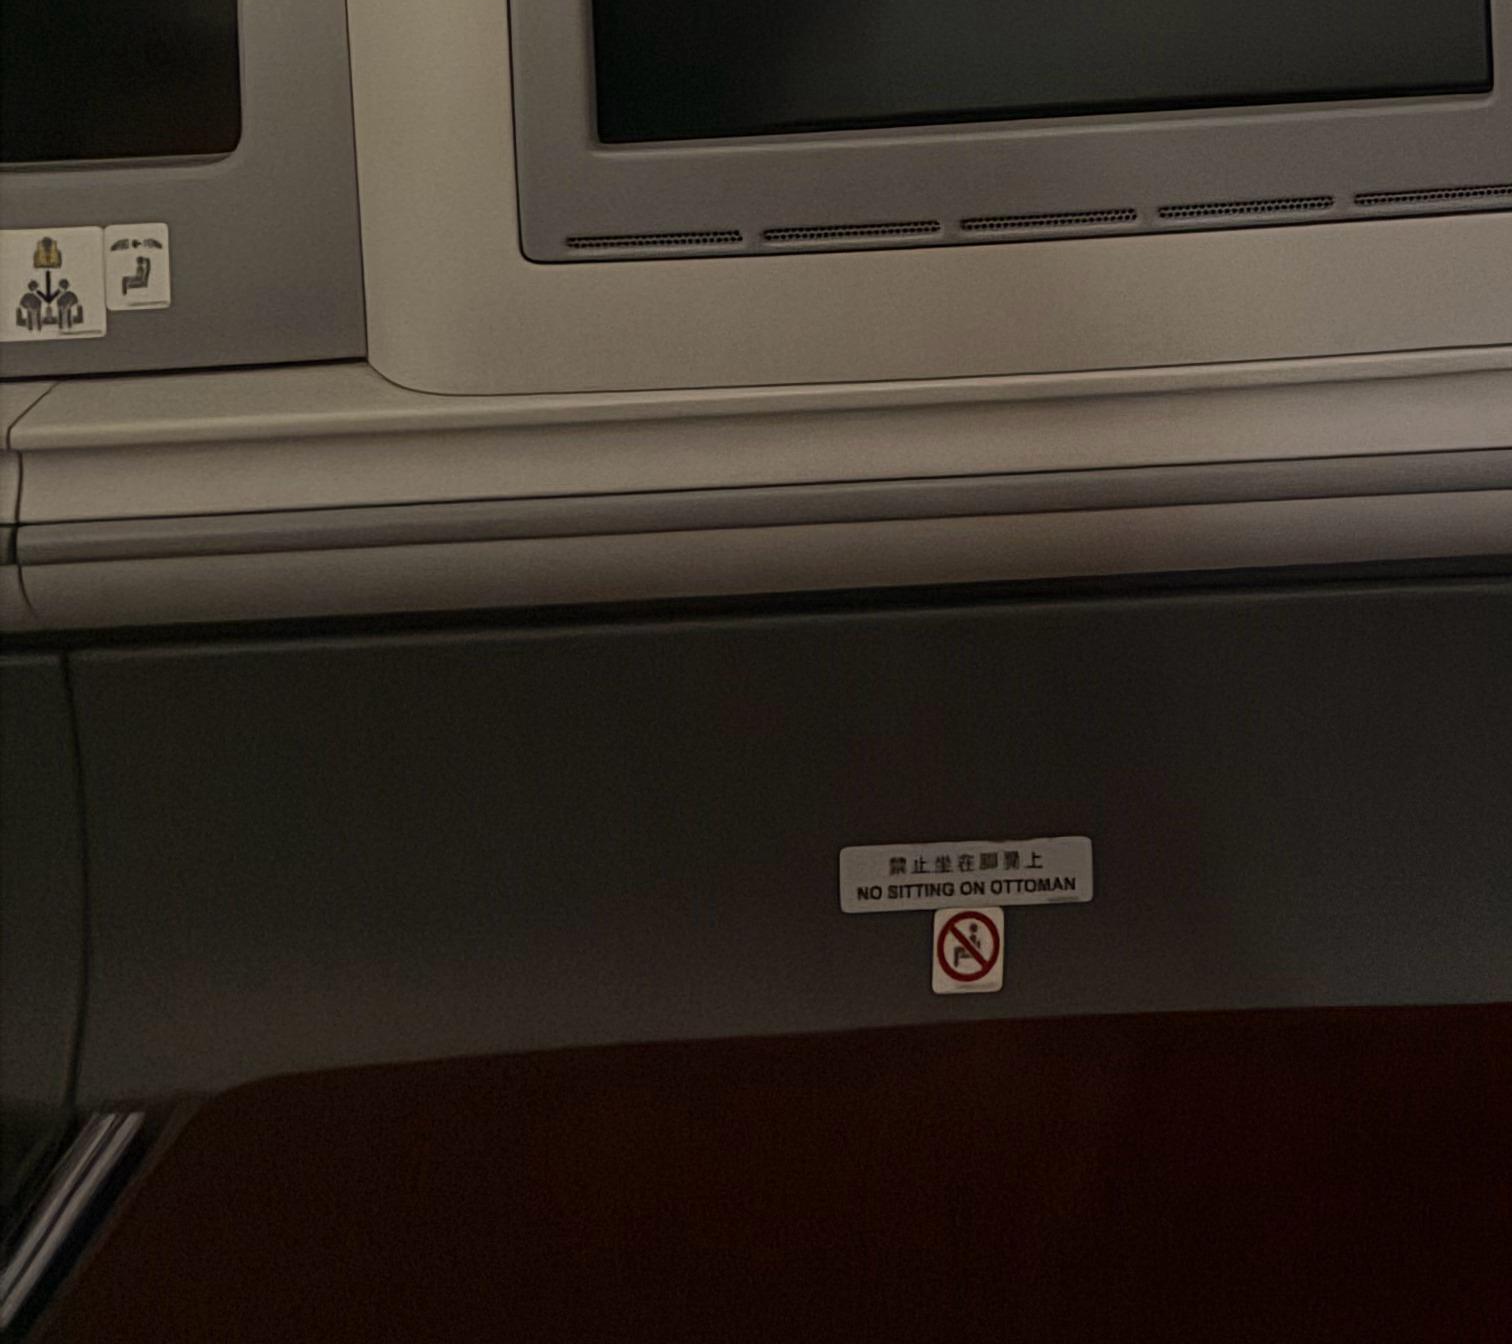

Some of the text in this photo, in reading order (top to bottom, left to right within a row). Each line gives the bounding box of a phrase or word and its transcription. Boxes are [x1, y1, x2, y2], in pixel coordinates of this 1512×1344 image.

[857, 876, 1076, 901] NO SITTING ON OTTOMAN
